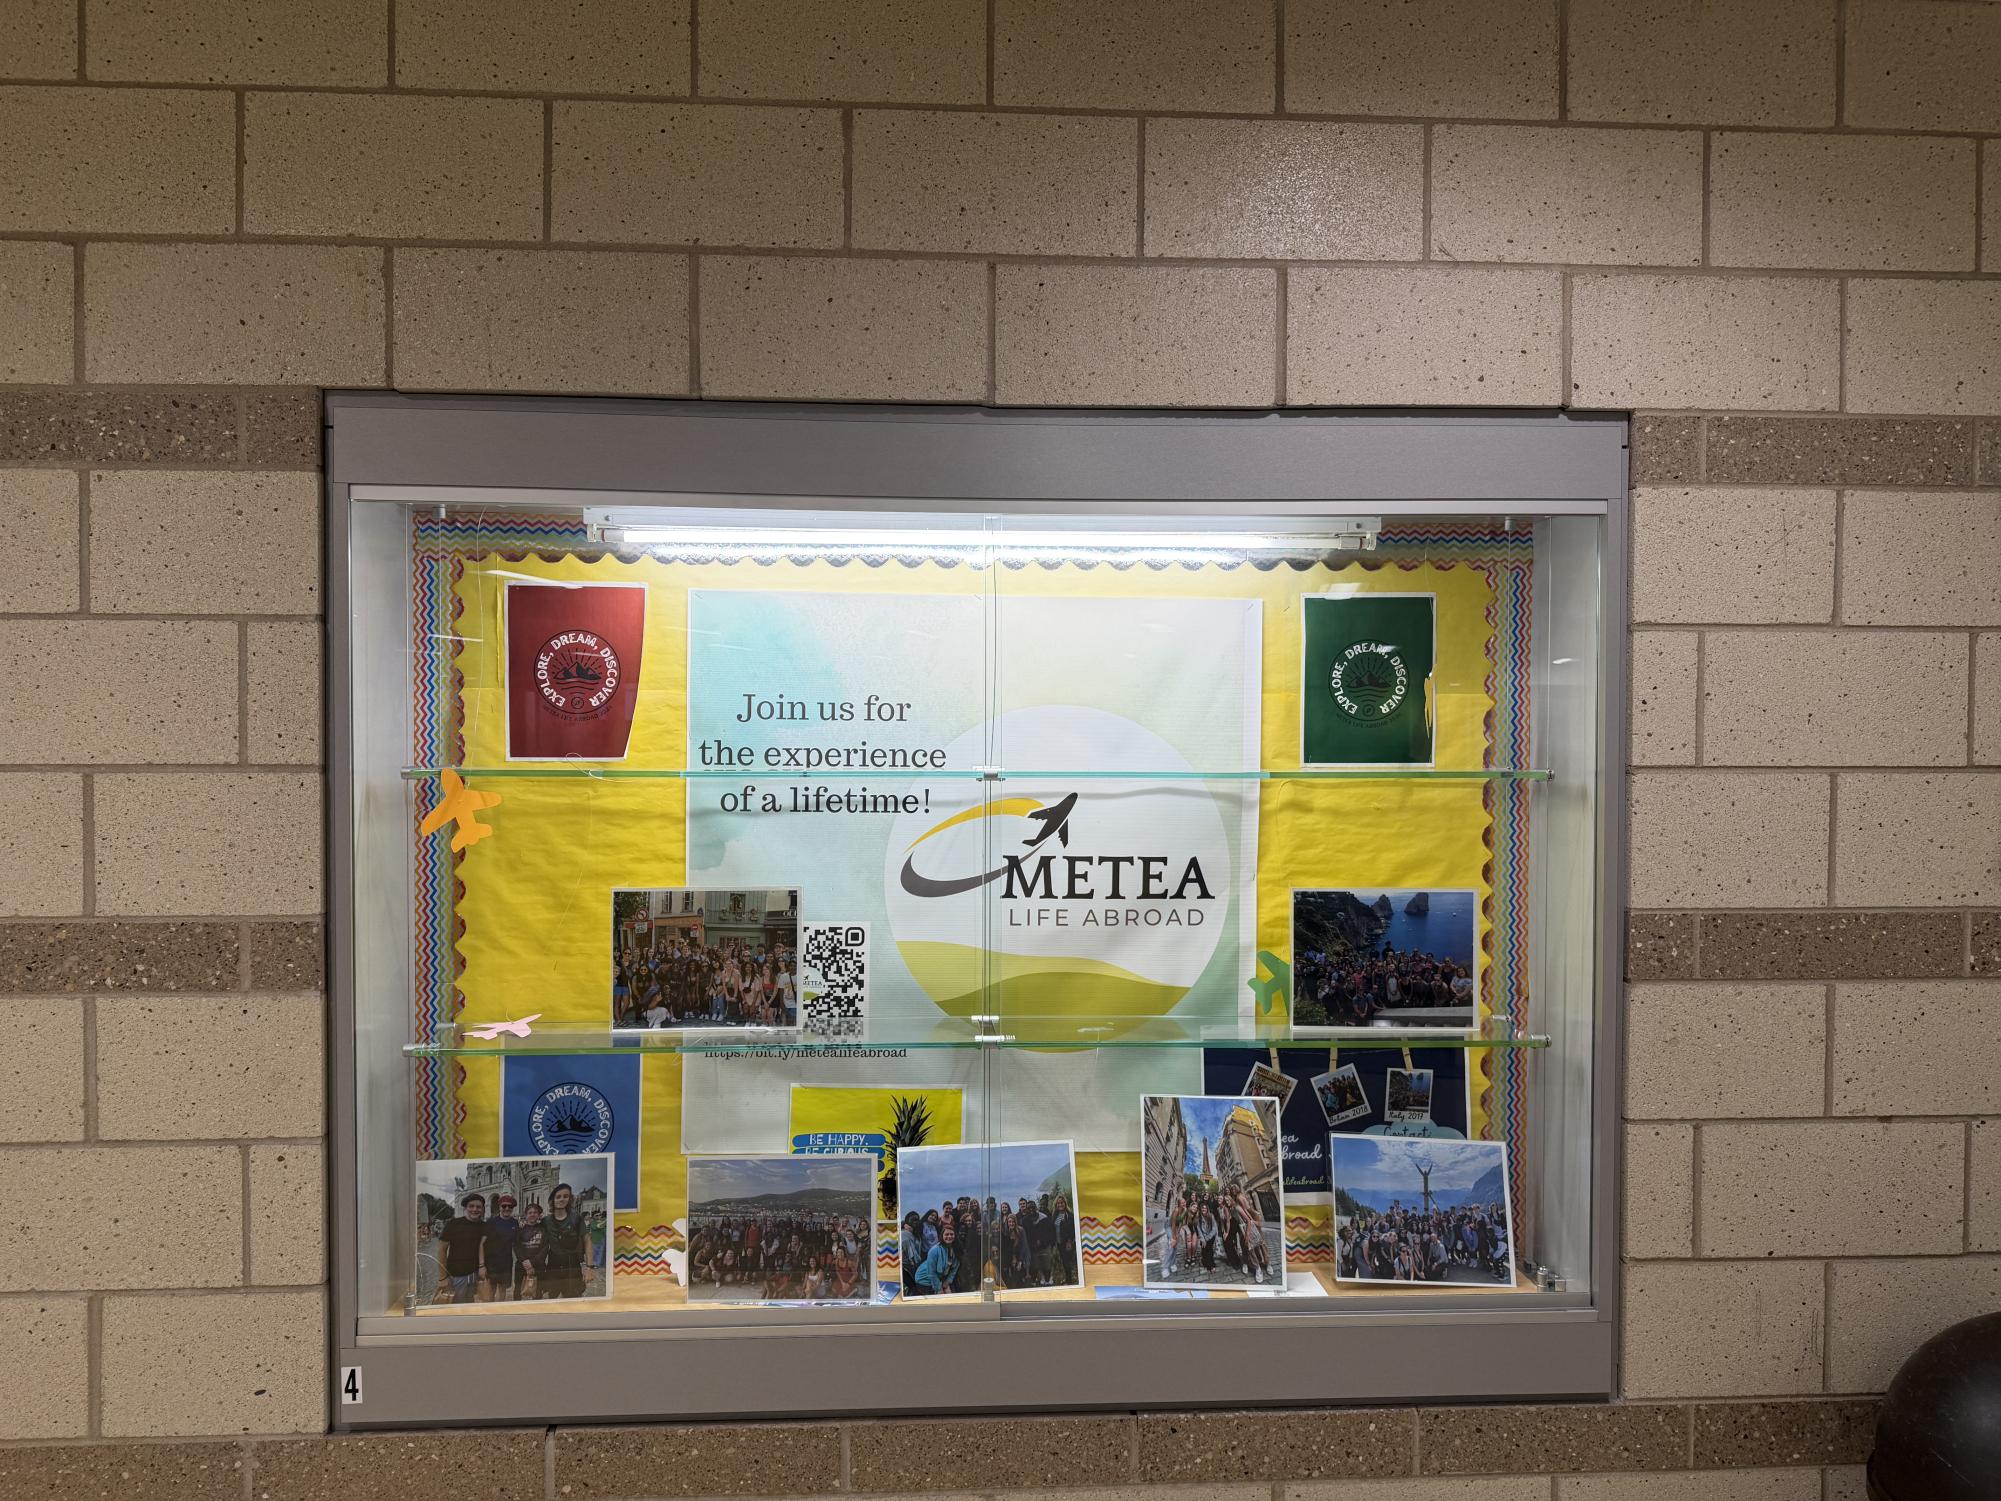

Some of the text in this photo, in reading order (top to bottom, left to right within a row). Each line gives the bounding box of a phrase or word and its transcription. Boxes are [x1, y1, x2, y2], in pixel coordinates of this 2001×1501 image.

[537, 633, 618, 707] EXPLORE, DREAM, DISCOVER
[1332, 643, 1407, 715] EXPLORE, DREAM, DISCOVER
[736, 693, 911, 722] Join us for
[698, 739, 947, 769] the experience
[720, 785, 930, 814] of a lifetime!
[1000, 855, 1216, 900] METEA
[1009, 908, 1204, 926] LIFE ABROAD
[532, 1105, 560, 1156] EXPLORE,
[546, 1085, 592, 1103] DREAM,
[1408, 1111, 1424, 1120] 2017
[809, 1134, 868, 1146] BE HAPPY.
[1281, 1144, 1322, 1159] broad
[344, 1368, 359, 1401] 4
